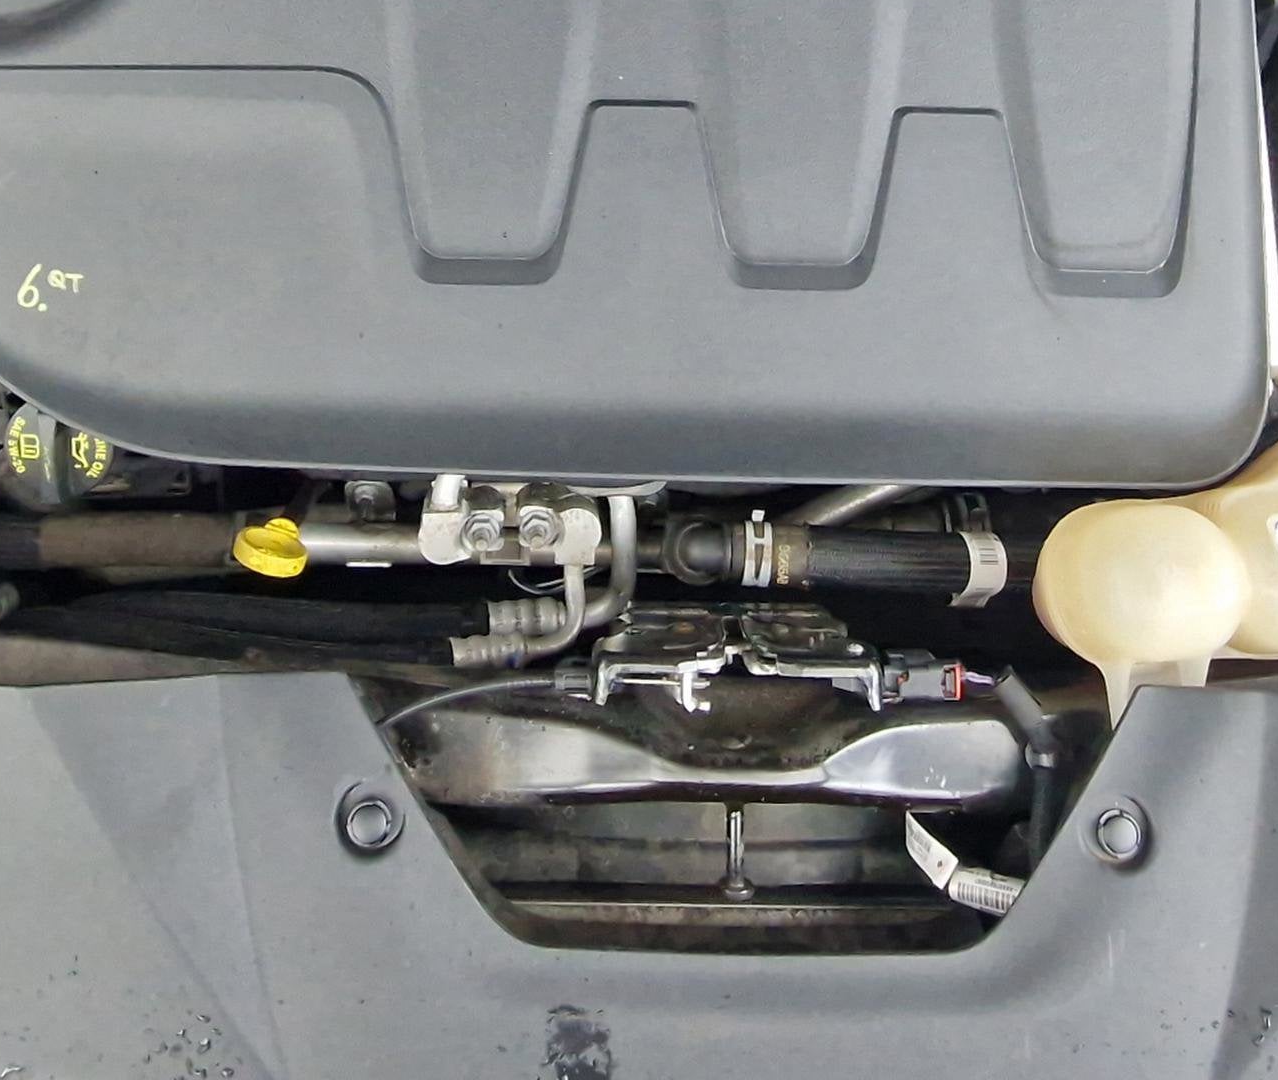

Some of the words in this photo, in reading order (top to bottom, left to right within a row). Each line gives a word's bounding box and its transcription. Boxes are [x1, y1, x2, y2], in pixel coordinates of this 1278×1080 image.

[8, 416, 26, 438] SAE
[7, 439, 26, 475] 5W-20
[86, 461, 105, 479] OIL
